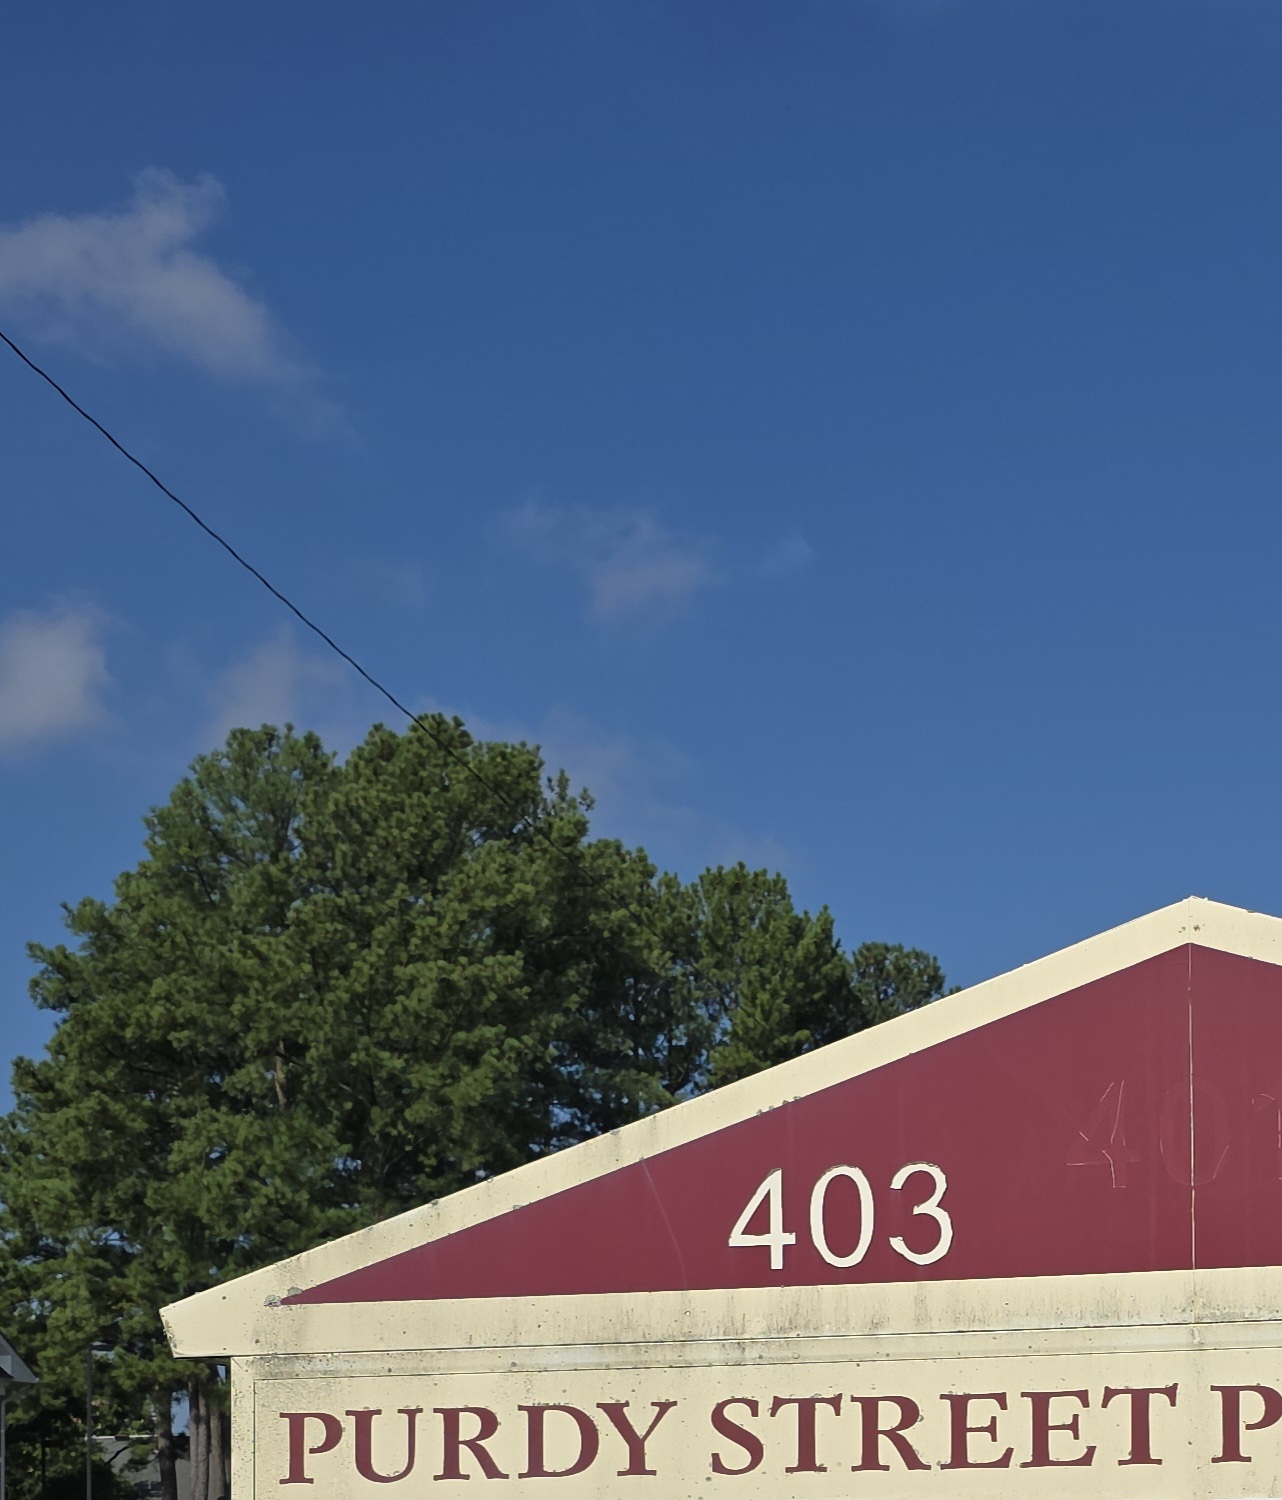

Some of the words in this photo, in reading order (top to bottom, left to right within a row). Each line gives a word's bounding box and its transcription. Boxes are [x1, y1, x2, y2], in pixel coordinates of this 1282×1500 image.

[729, 1164, 952, 1269] 403
[279, 1399, 677, 1484] PURDY
[710, 1383, 1178, 1477] STREET
